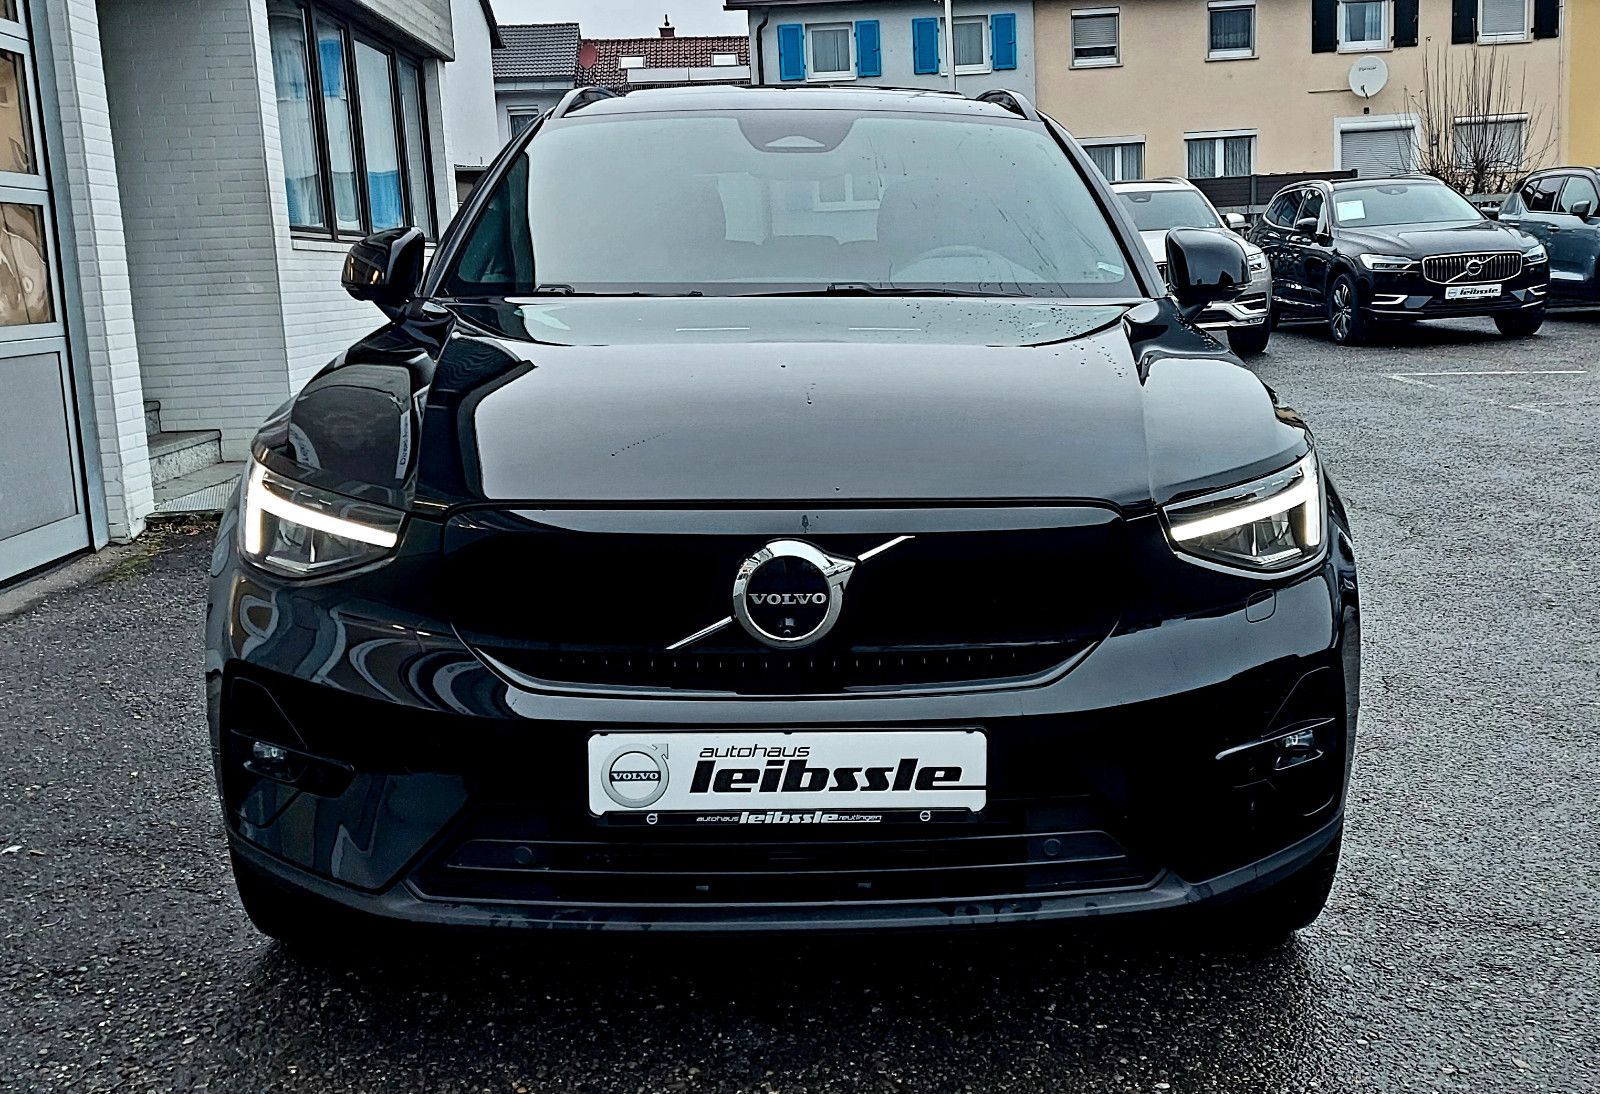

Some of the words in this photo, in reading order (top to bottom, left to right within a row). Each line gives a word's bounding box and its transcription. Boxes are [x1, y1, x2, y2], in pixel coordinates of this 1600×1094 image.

[748, 592, 828, 605] VOLVO
[699, 743, 811, 758] autohaus
[611, 772, 659, 780] VOLVO
[689, 758, 966, 793] leibssle
[739, 811, 839, 824] leibssle
[838, 814, 883, 822] reutlingen
